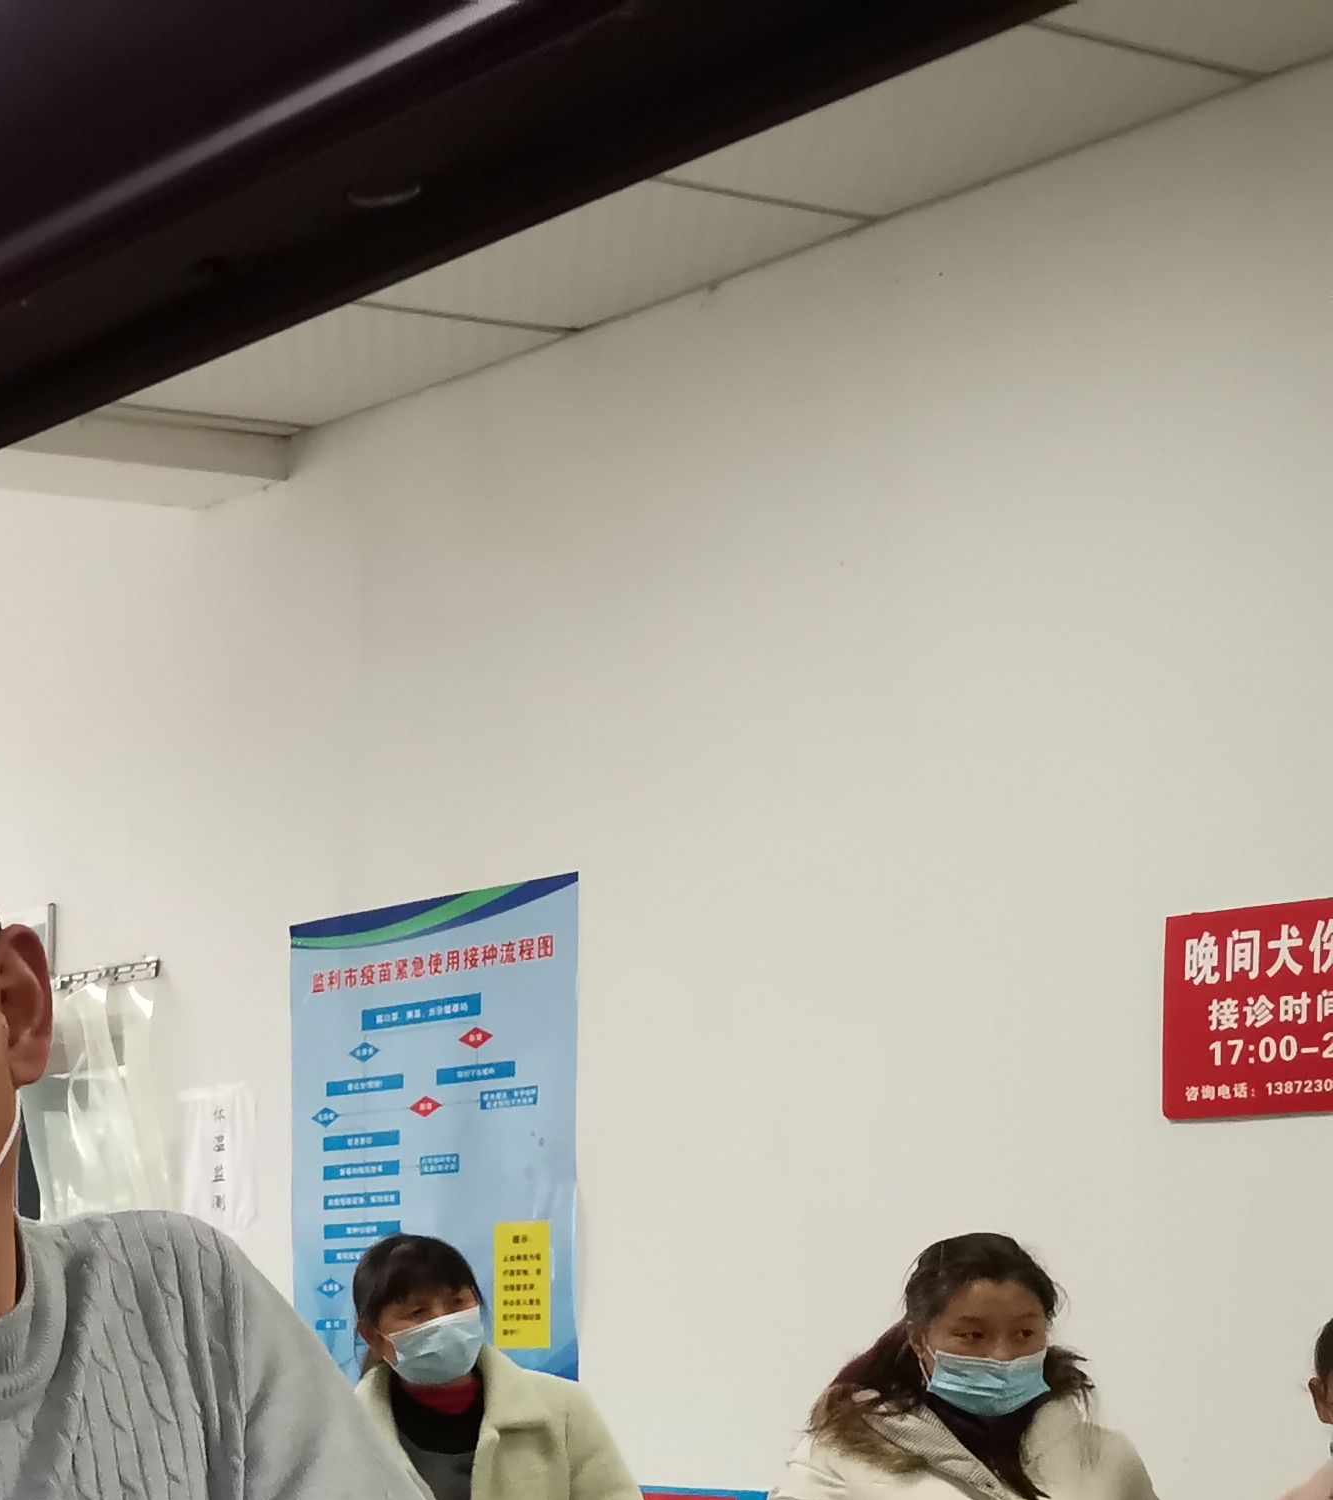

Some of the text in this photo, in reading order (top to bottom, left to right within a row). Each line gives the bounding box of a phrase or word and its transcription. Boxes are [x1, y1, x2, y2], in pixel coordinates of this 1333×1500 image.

[312, 934, 554, 994] 监利市疫苗紧急使用接种流程图
[1184, 917, 1333, 985] 晚间犬伤
[1208, 989, 1333, 1031] 接诊时间
